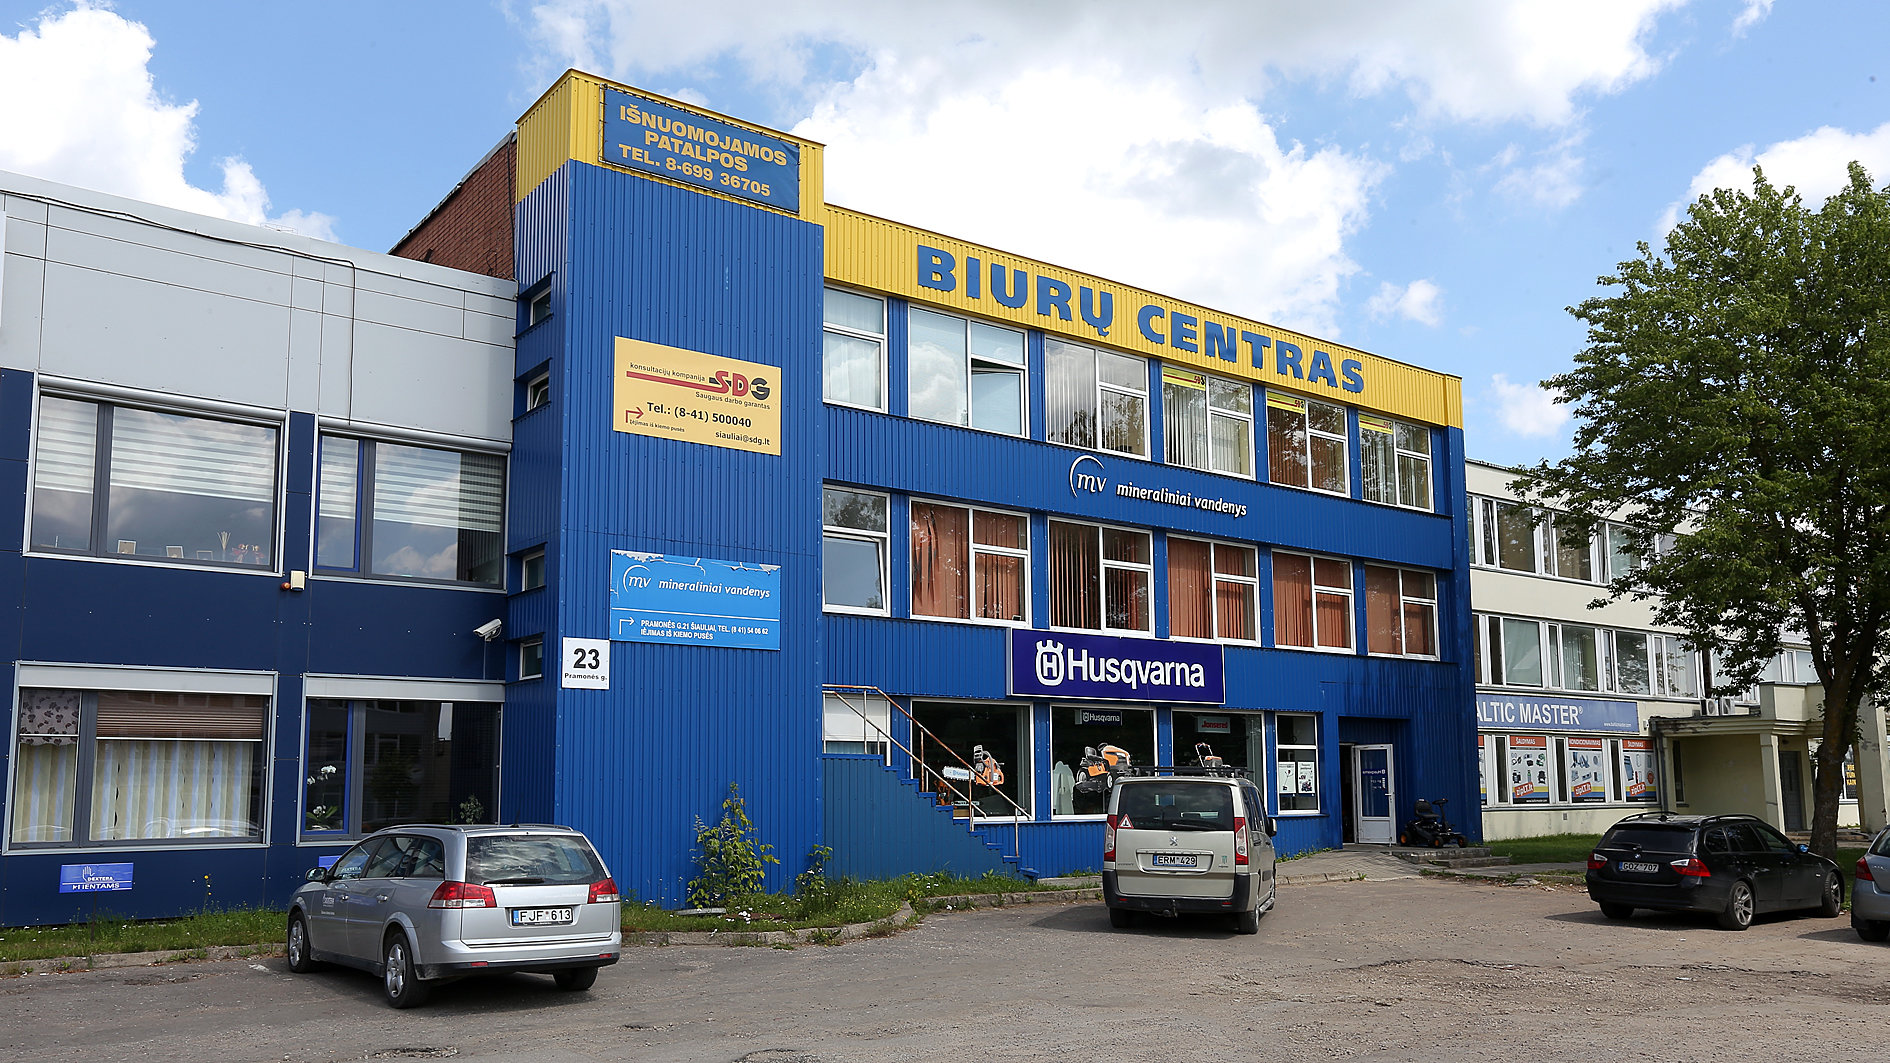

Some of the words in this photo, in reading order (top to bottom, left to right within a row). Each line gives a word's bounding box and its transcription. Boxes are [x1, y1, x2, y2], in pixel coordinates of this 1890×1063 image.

[620, 103, 788, 167] IŠNUOMOJAMOS
[645, 130, 749, 172] PATALPOS
[618, 143, 661, 167] TEL.
[665, 157, 714, 182] 8-699
[720, 172, 771, 197] 36705
[917, 244, 1113, 337] BIURŲ
[1137, 304, 1365, 394] CENTRAS
[630, 362, 671, 376] konsultacijų
[672, 368, 706, 382] kompanija
[709, 370, 771, 401] SDG
[695, 391, 723, 402] Saugaus
[724, 396, 743, 406] darbo
[743, 400, 771, 410] garantas
[647, 401, 671, 415] Tel.:
[674, 406, 709, 423] (8-41)
[712, 413, 752, 428] 500040
[715, 431, 770, 446] siauliai@sdg.lt
[1116, 482, 1192, 508] mineraliniai
[1193, 496, 1248, 518] vandenys
[658, 579, 722, 594] mineraliniai
[724, 584, 771, 599] vandenys
[640, 619, 676, 629] PRAMONĖS
[673, 631, 693, 639] KIEMO
[693, 631, 714, 640] PUSĖS
[573, 648, 600, 670] 23
[1067, 648, 1205, 690] Husqvarna
[564, 672, 600, 680] Pramonės
[600, 673, 608, 681] g.
[1089, 712, 1121, 723] Husqvarna
[1157, 856, 1176, 864] ERM
[1180, 856, 1196, 865] 429
[1643, 863, 1658, 871] 707
[519, 910, 544, 921] FJF
[551, 909, 571, 920] 613
